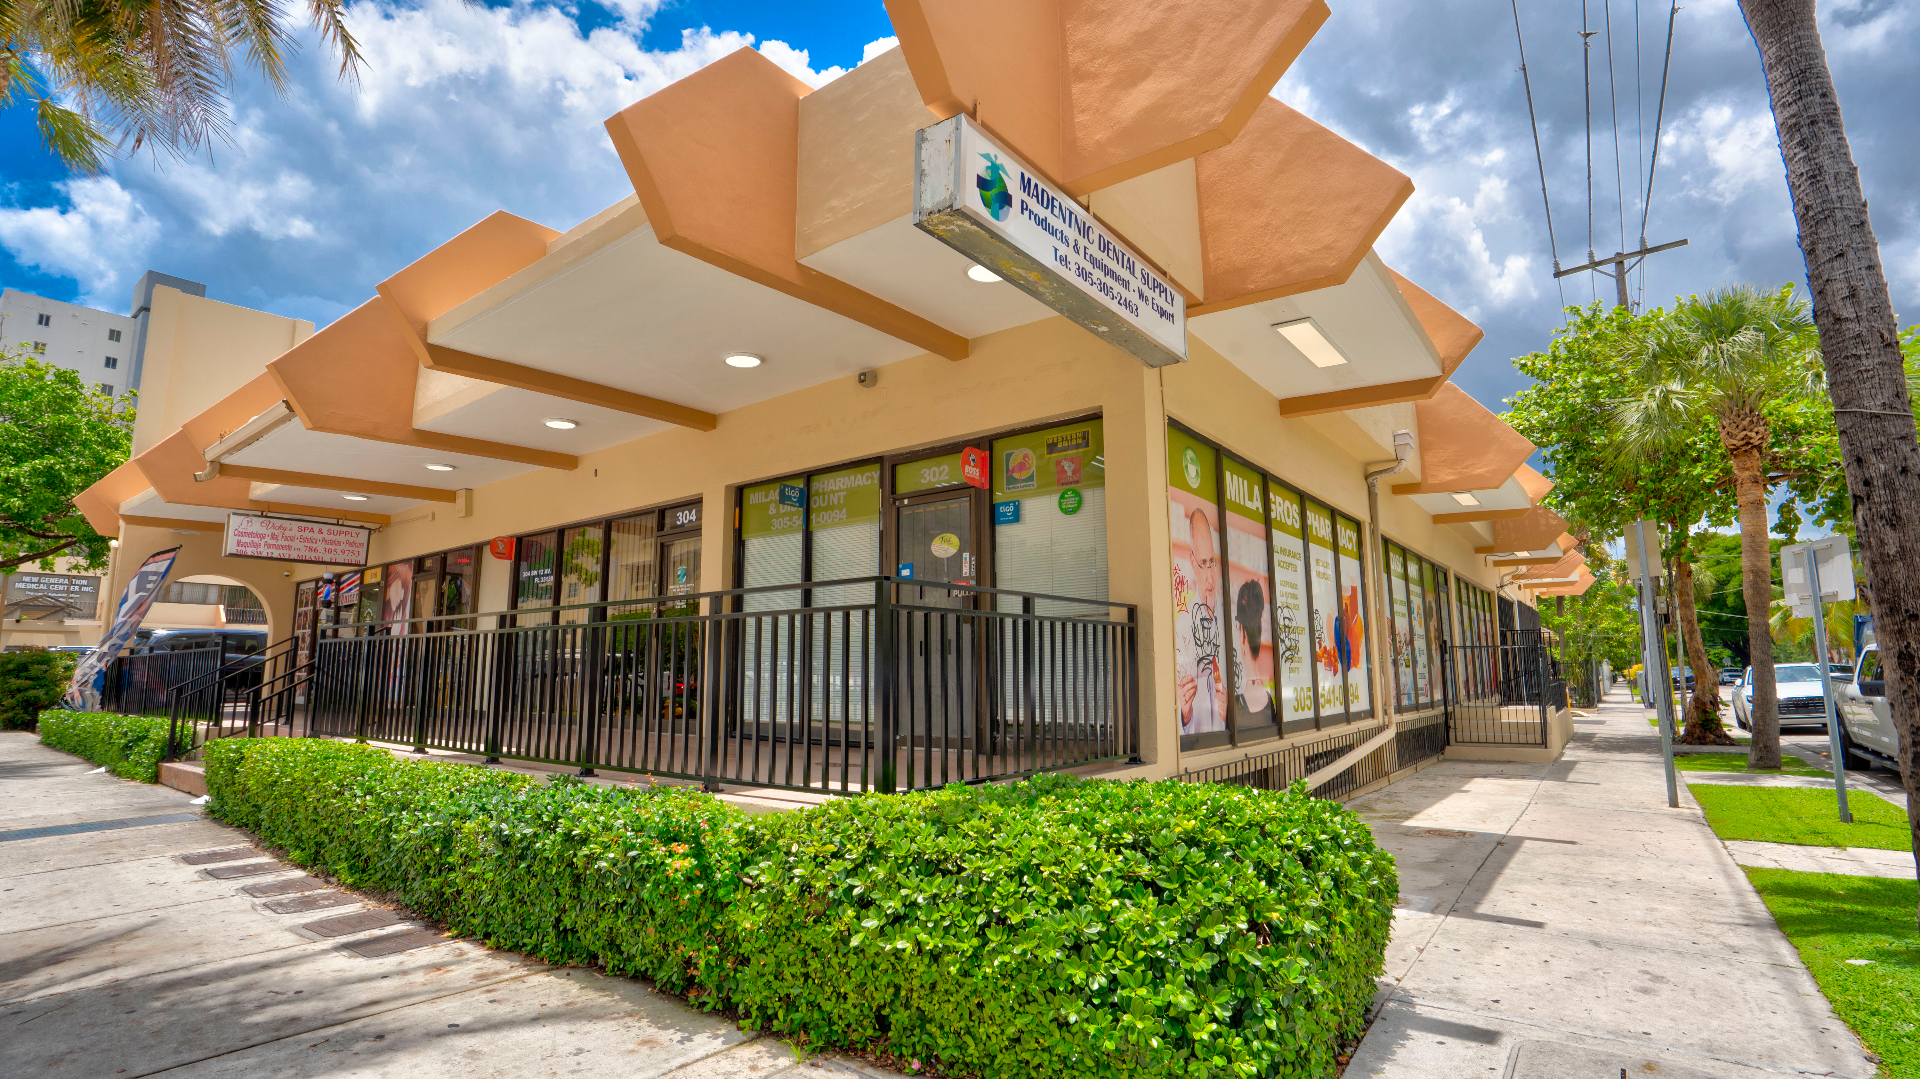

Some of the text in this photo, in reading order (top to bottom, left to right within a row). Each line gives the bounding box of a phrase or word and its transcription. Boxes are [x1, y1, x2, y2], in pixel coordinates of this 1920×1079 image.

[1019, 171, 1175, 308] MADENTNIC DENTAL SUPPLY
[1020, 198, 1070, 247] Products
[1073, 238, 1081, 256] &
[1083, 248, 1131, 292] Equipment
[1137, 286, 1150, 307] We
[1151, 298, 1175, 325] Export
[1052, 245, 1139, 318] Tel: 305-305-2463
[1046, 432, 1082, 444] WESTERN
[1058, 437, 1082, 447] UNION
[920, 464, 949, 484] 302
[964, 465, 980, 477] BOSS
[811, 470, 880, 494] PHARMACY
[676, 508, 697, 526] 304
[768, 503, 777, 515] &
[260, 519, 293, 533] Vicky's
[297, 525, 315, 534] SPA
[326, 529, 361, 538] SUPPLY
[236, 539, 262, 550] Maquillaje
[264, 541, 293, 551] Permanente
[303, 545, 361, 558] 786.305.9753
[281, 533, 296, 542] Facial
[345, 539, 365, 549] Pedicure
[1279, 546, 1302, 562] INSURANCE
[1277, 559, 1298, 573] ACCEPTED
[15, 582, 48, 590] MEDICAL
[22, 575, 39, 583] NEW
